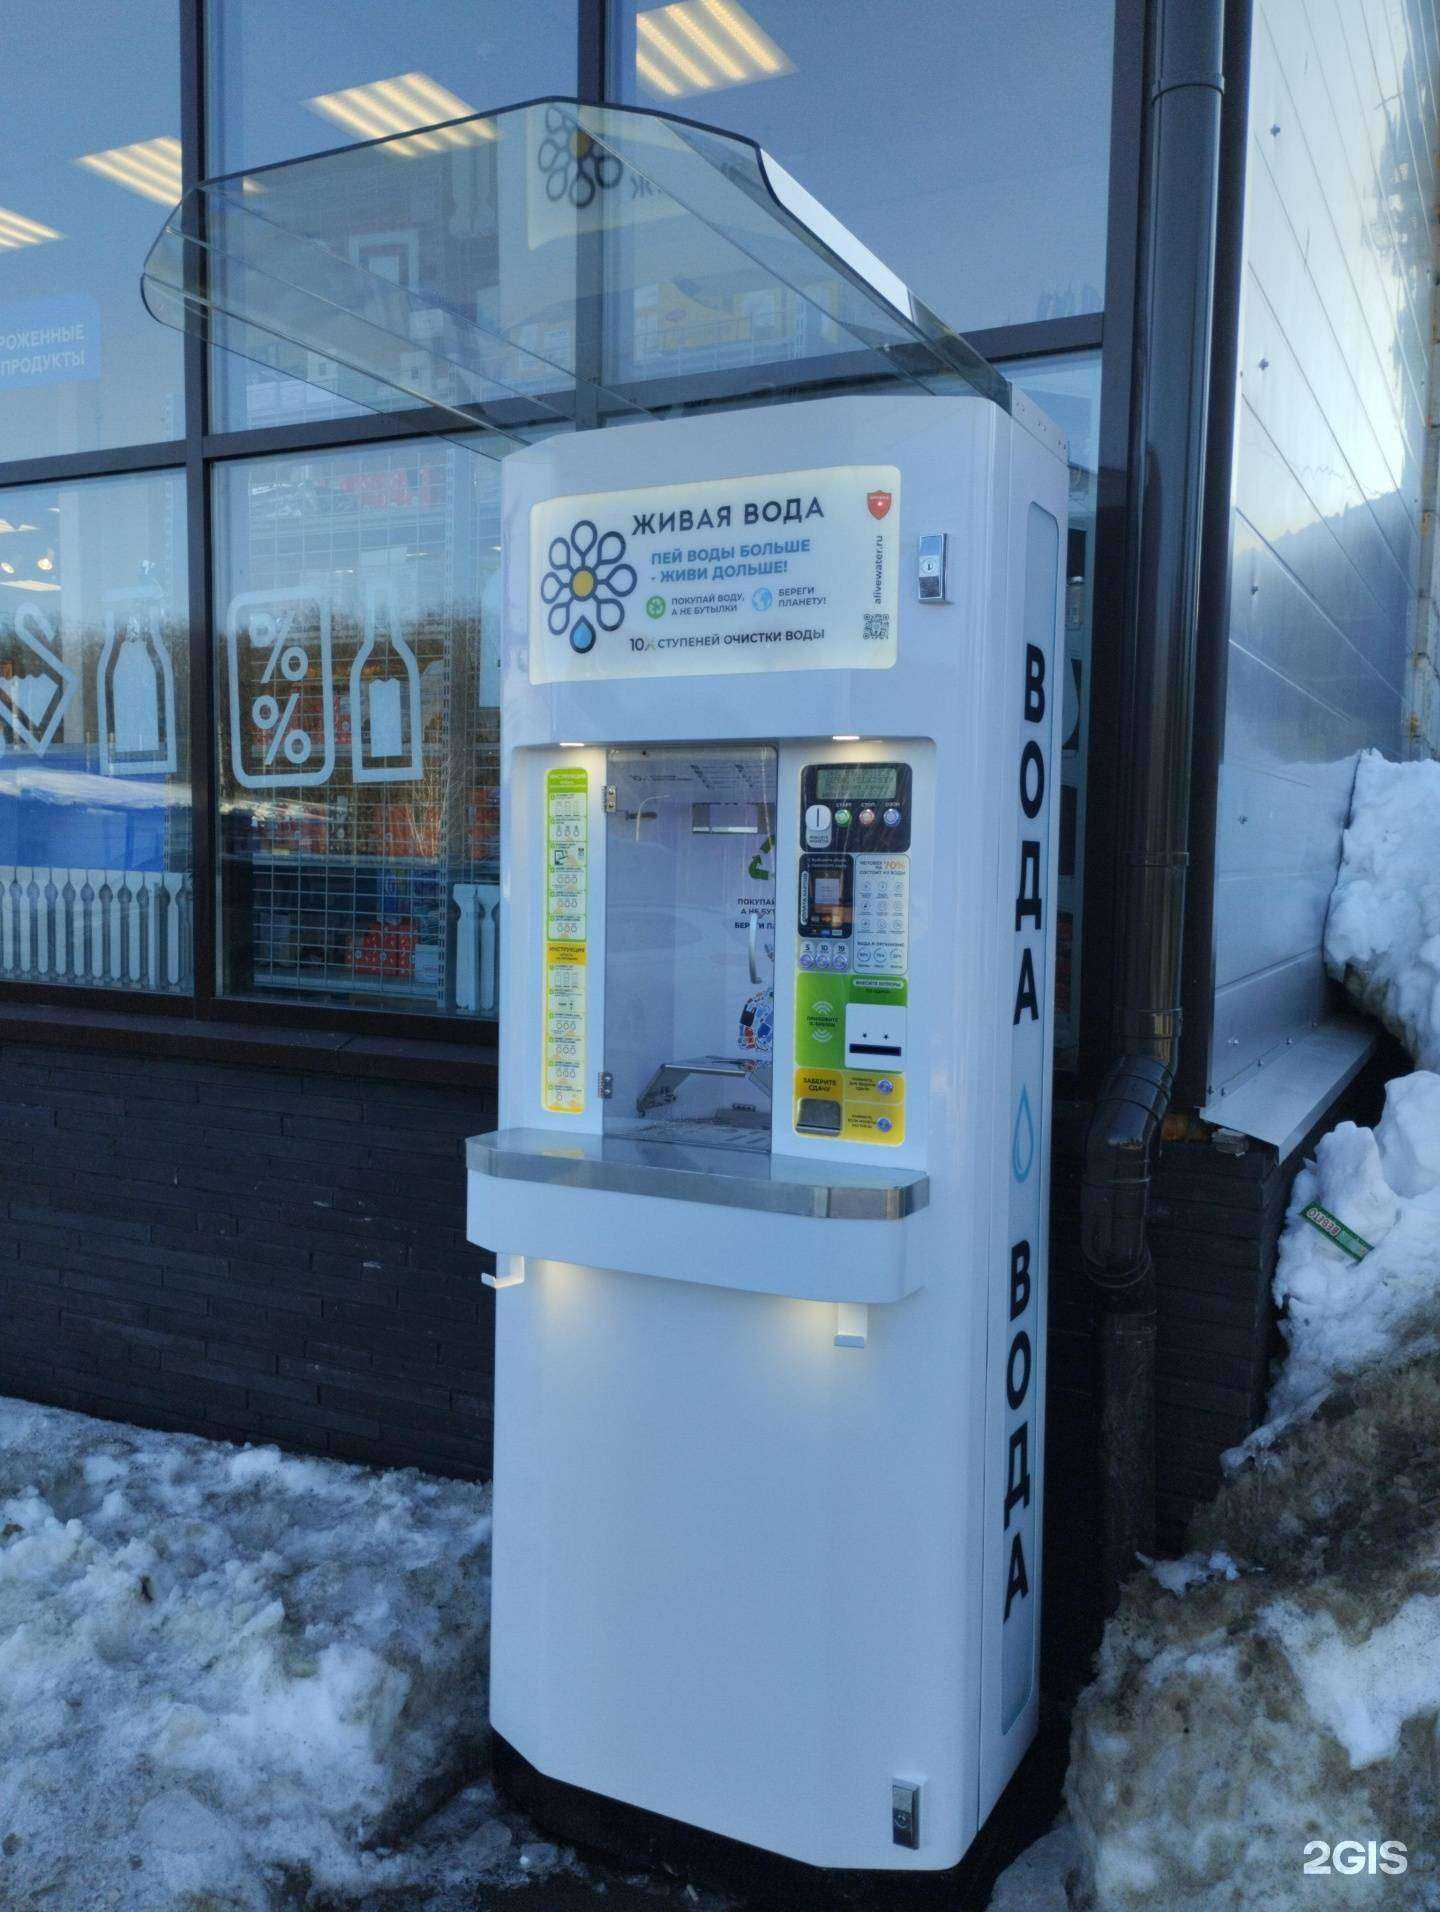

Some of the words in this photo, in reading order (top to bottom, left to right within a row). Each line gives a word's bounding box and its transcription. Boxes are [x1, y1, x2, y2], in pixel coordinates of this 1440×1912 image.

[1, 350, 85, 376] ПРОДУКТЫ
[632, 505, 731, 536] ЖИВАЯ
[744, 496, 825, 525] ВОДА
[651, 548, 683, 565] ПЕЙ
[687, 546, 735, 562] ВОДЫ
[740, 539, 811, 557] БОЛЬШЕ
[660, 568, 708, 583] ЖИВИ
[712, 560, 788, 581] ДОЛЬШЕ!
[873, 535, 883, 605] alivewater.ru
[671, 593, 716, 605] ПОКУПАЙ
[778, 587, 815, 597] БЕРЕГИ
[778, 597, 827, 607] ПЛАНЕТУ!
[671, 608, 678, 616] А
[679, 607, 692, 616] НЕ
[694, 604, 738, 615] БУТЫЛКИ
[657, 634, 720, 648] СТУПЕНЕЙ
[723, 632, 781, 644] ОЧИСТКИ
[785, 629, 825, 641] ВОДЫ
[1012, 643, 1046, 1026] ВОДА
[1003, 1239, 1032, 1625] ВОДА
